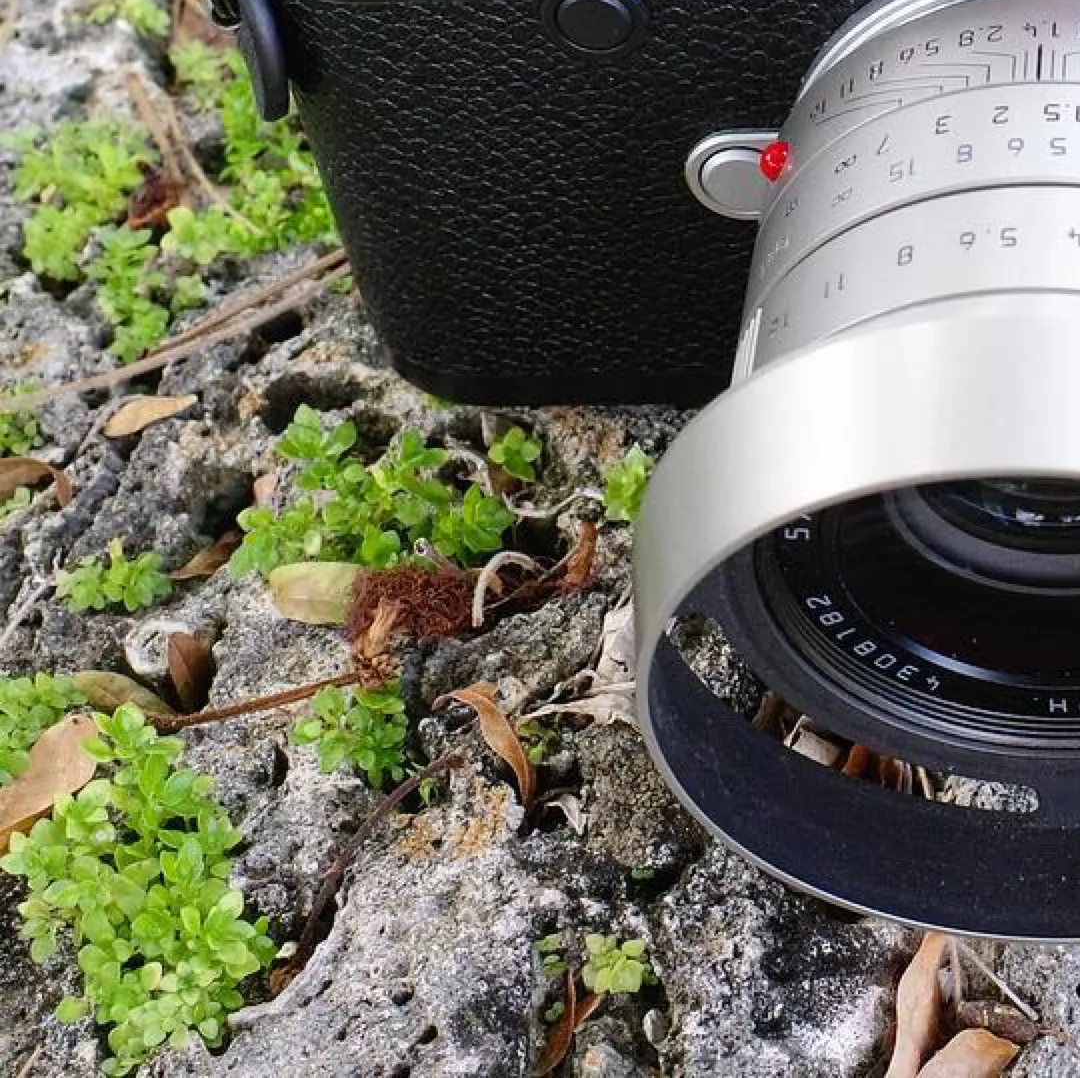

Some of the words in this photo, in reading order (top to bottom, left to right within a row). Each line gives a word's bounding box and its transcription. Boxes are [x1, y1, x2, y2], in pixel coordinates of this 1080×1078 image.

[958, 25, 1004, 48] 2.8
[935, 115, 952, 135] 3
[993, 106, 1009, 124] 2
[957, 143, 973, 164] 8
[1008, 138, 1024, 157] 6
[1050, 137, 1067, 157] 5
[889, 156, 915, 182] 15
[960, 227, 1017, 251] 5.6
[897, 245, 914, 266] 8
[823, 273, 845, 299] 11
[805, 594, 941, 691] 4308182
